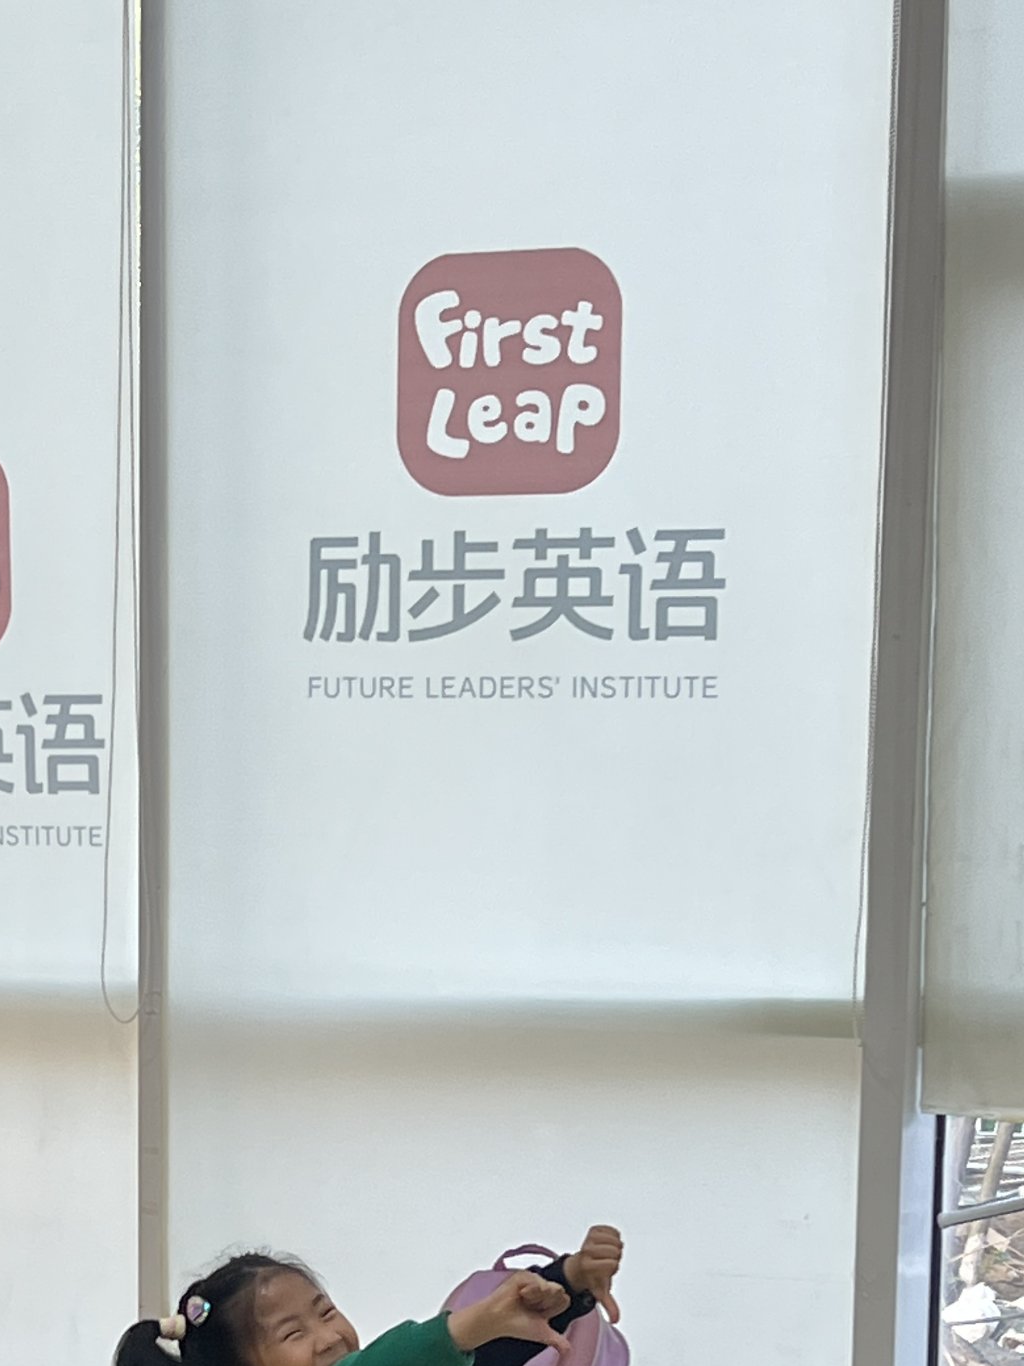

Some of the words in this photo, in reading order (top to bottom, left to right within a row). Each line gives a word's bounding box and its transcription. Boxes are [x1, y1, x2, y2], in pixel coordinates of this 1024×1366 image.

[414, 290, 603, 369] First
[303, 527, 727, 643] 励步英语
[307, 675, 414, 699] FUTURE
[572, 675, 719, 700] INSTITUTE
